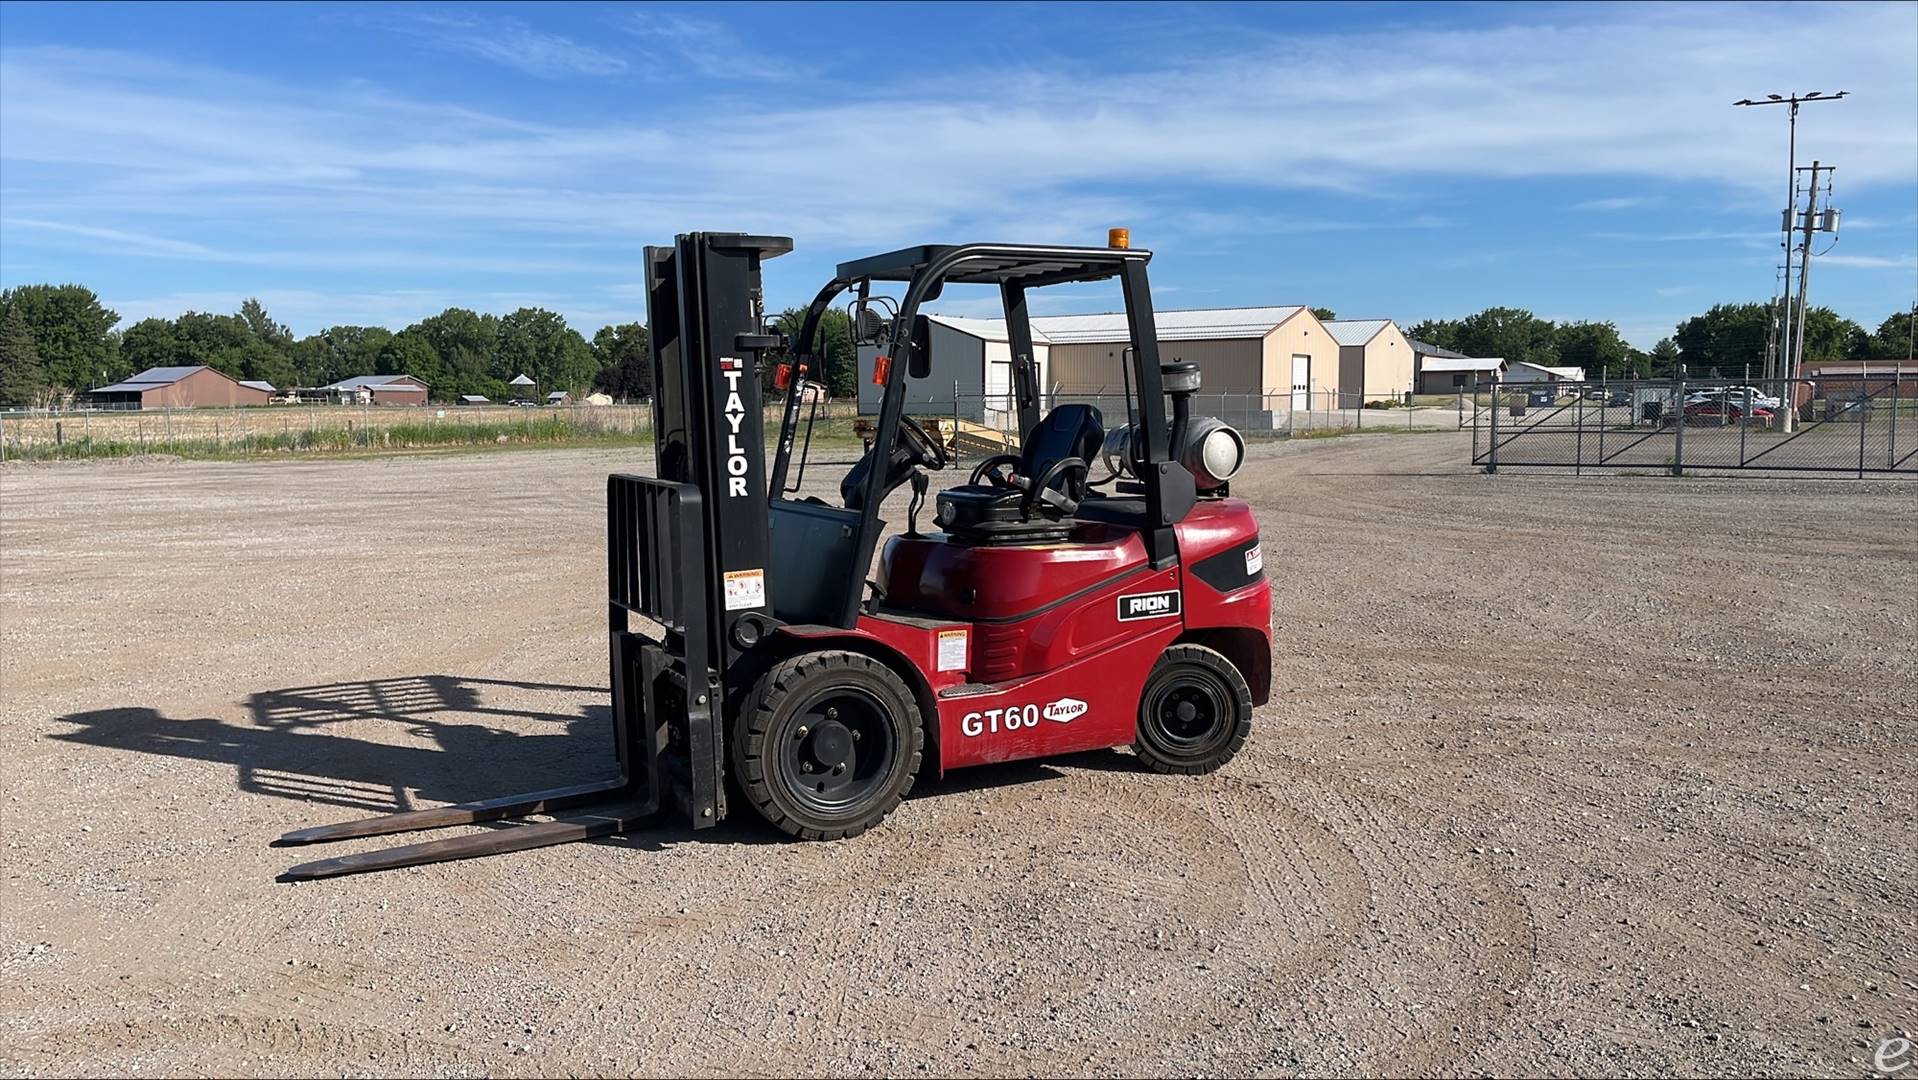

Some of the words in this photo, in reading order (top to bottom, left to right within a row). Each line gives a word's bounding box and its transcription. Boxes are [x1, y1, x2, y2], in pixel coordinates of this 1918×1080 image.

[724, 371, 748, 497] TAYLOR
[1130, 595, 1170, 615] RION
[962, 704, 1039, 737] GT60
[1047, 704, 1084, 717] TAYLOR
